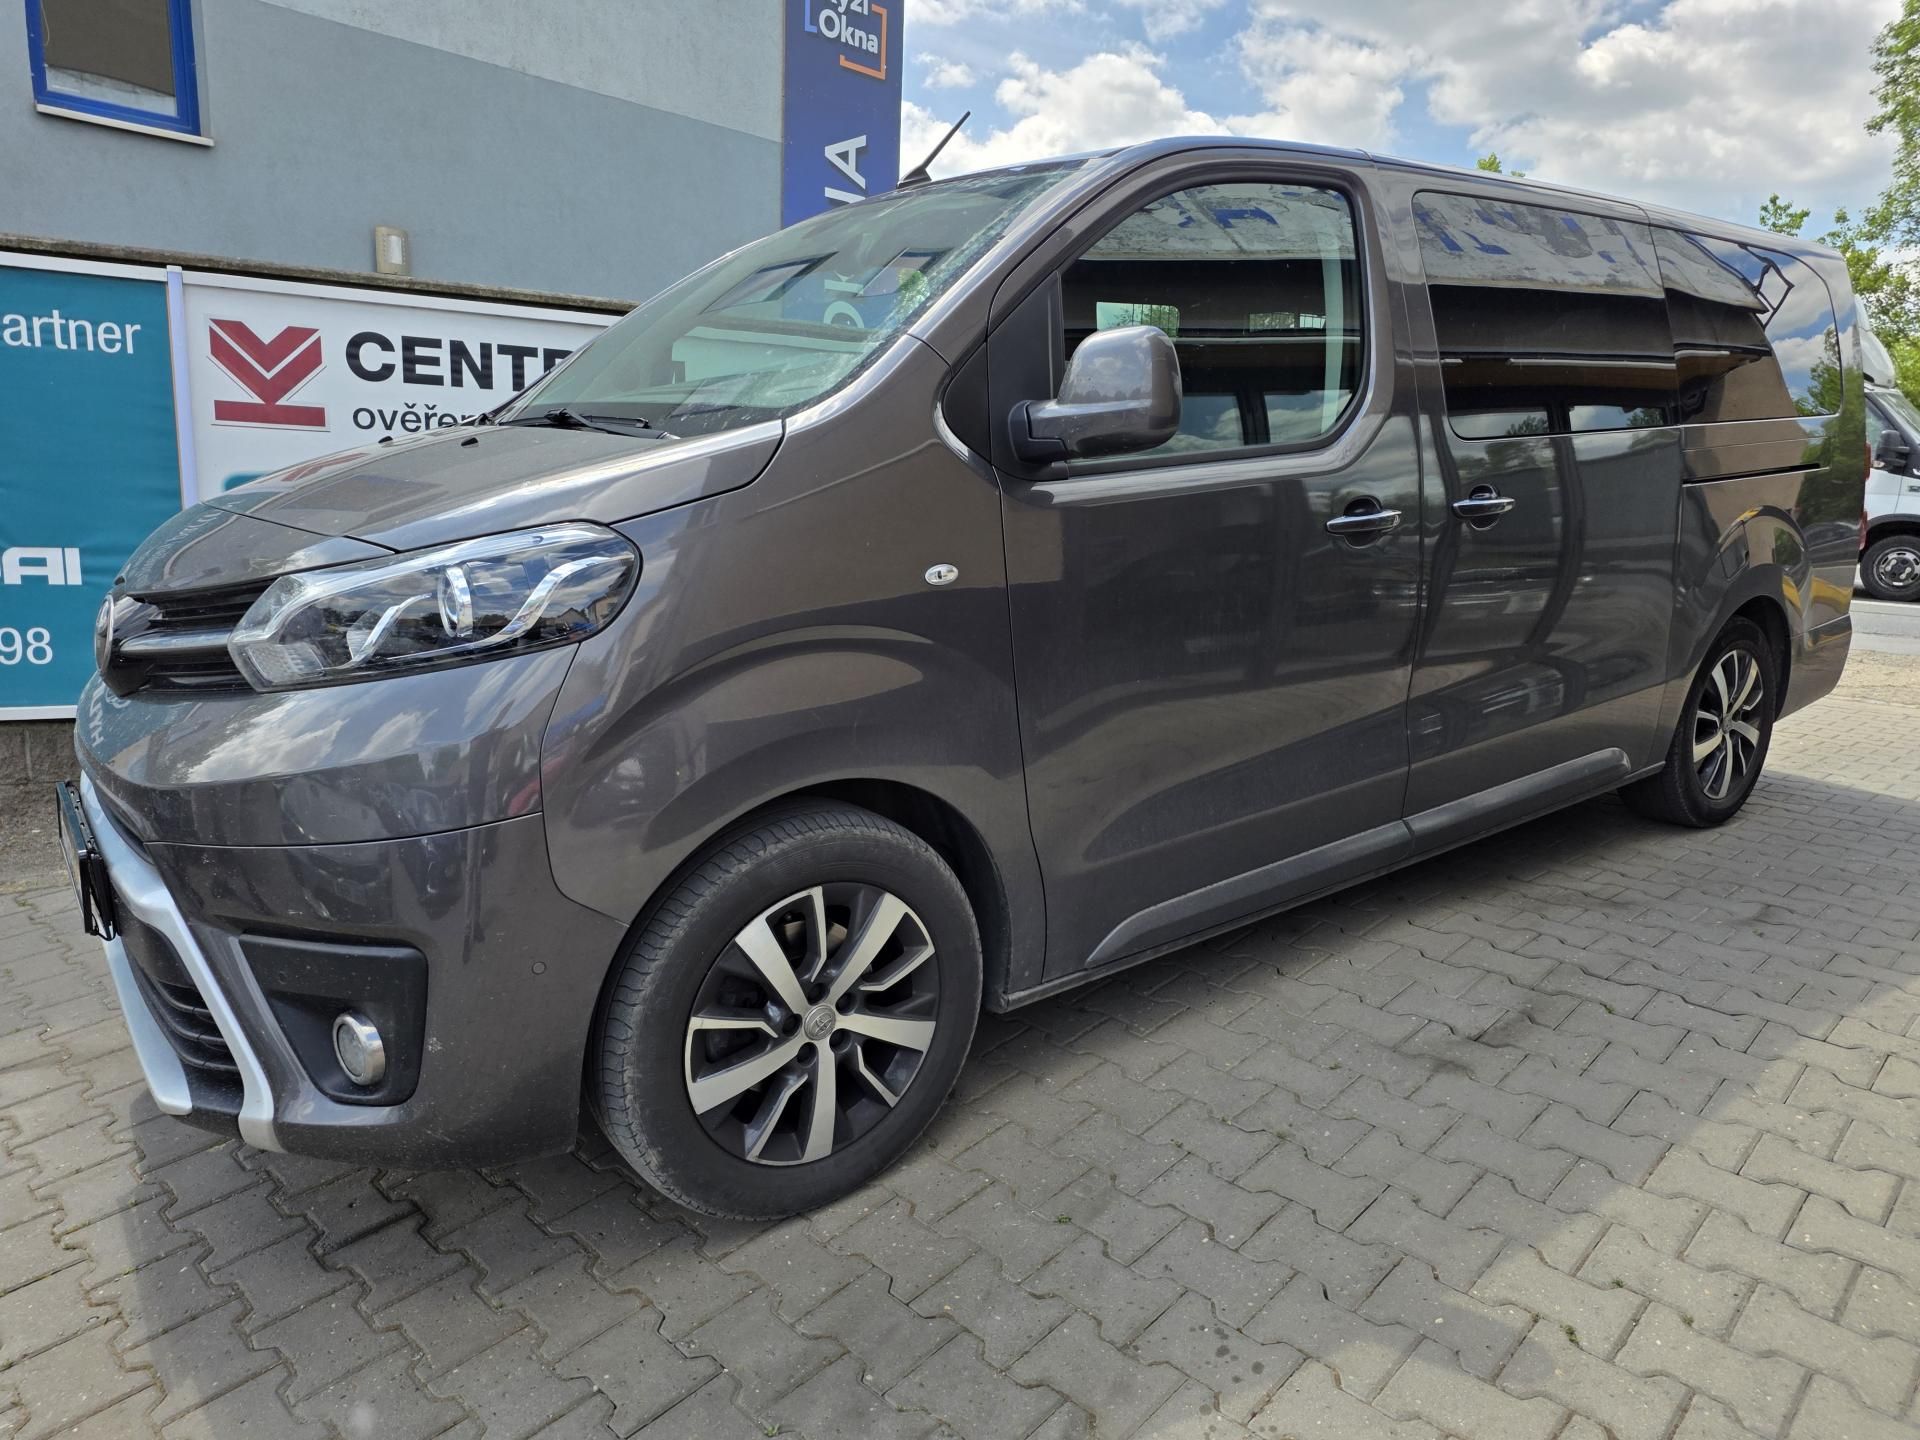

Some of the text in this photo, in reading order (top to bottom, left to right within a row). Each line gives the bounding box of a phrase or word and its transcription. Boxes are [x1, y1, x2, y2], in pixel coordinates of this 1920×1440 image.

[819, 9, 878, 54] Okna
[2, 309, 142, 354] artner
[0, 546, 82, 585] AI
[0, 627, 53, 665] 98
